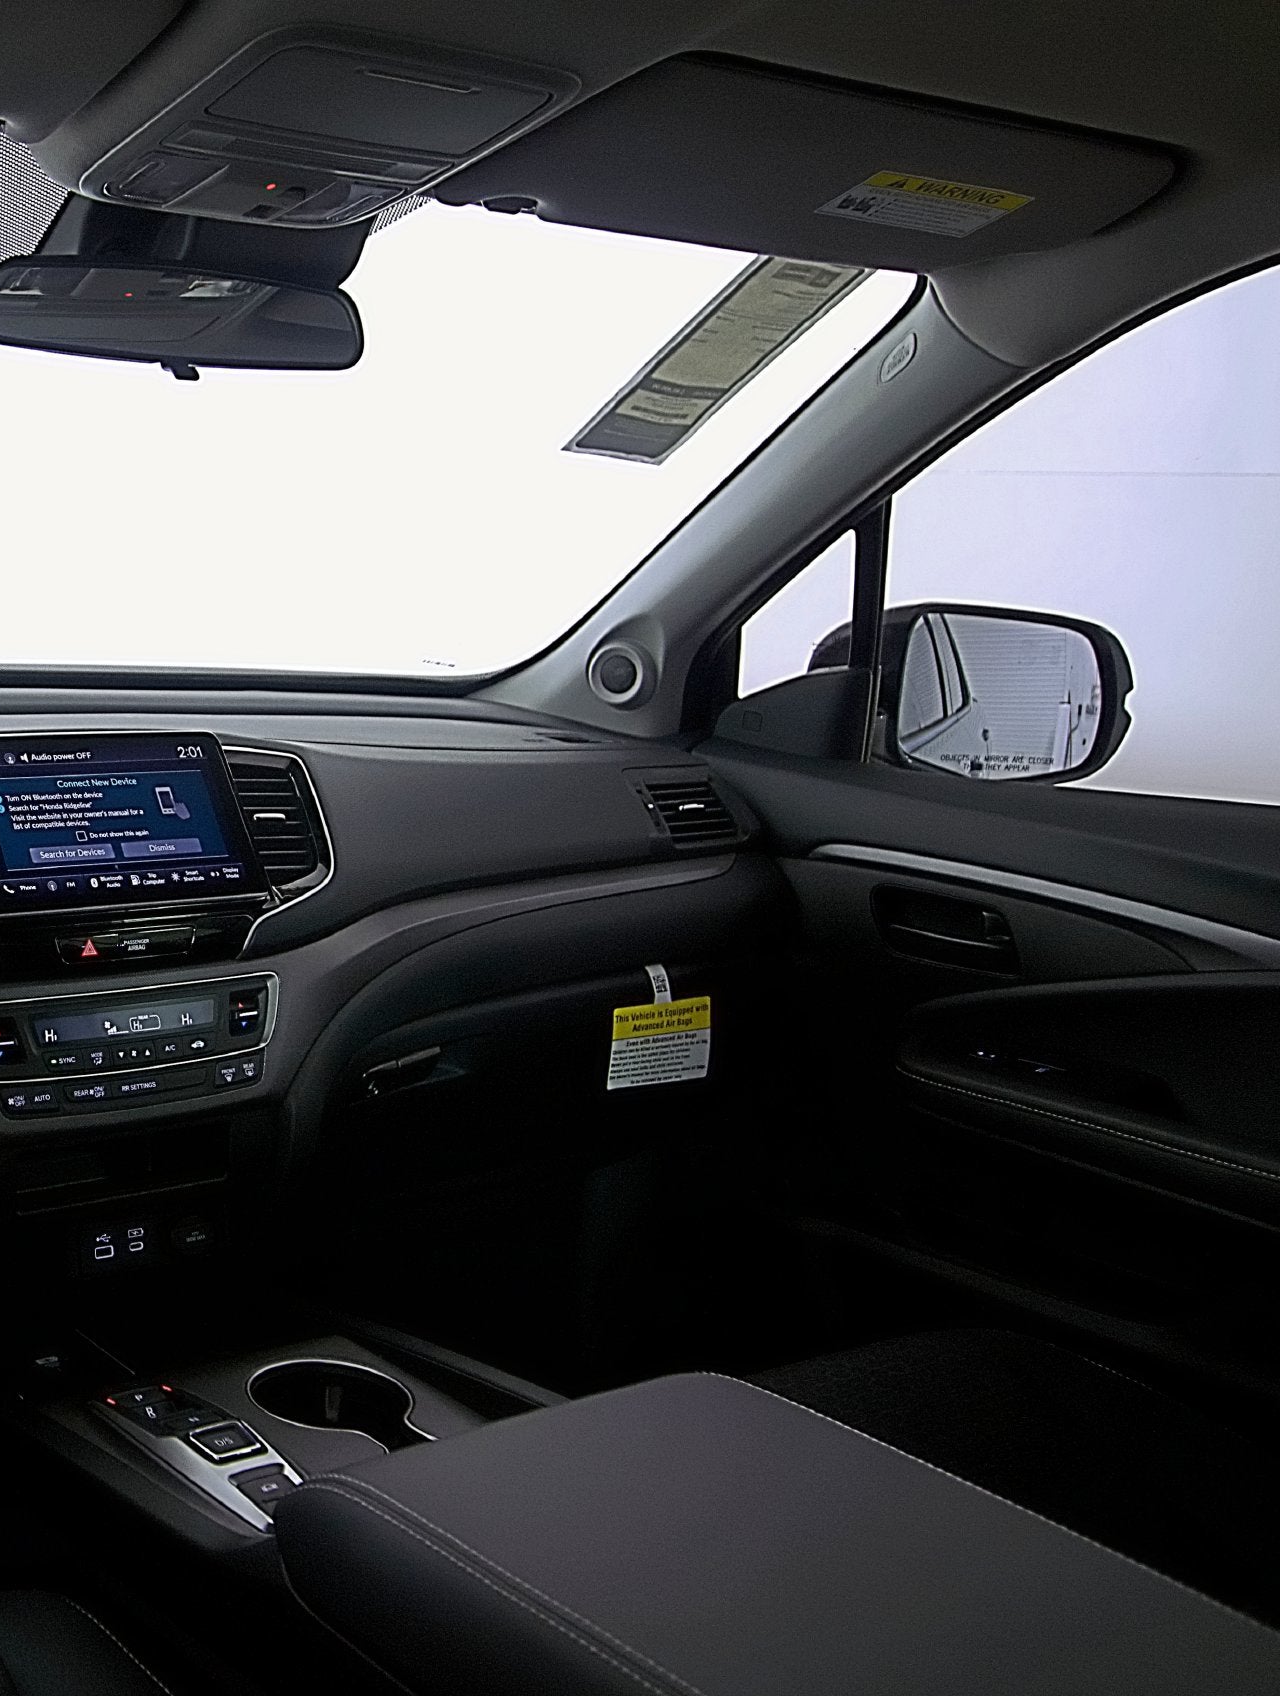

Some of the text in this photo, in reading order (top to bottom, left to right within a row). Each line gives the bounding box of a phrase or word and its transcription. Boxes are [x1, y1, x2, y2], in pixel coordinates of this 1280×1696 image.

[916, 181, 1005, 205] WARNING
[31, 751, 91, 761] Audio power OFF
[177, 746, 203, 758] 2:01
[940, 754, 970, 763] OBJECTS
[984, 755, 1009, 763] MIRROR
[1028, 757, 1054, 765] CLOSER
[984, 763, 1000, 771] THEY
[1004, 764, 1030, 772] APPEAR
[57, 777, 138, 788] Connect New Device
[32, 793, 63, 801] Bluetooth
[8, 804, 29, 812] Search
[30, 803, 39, 811] for
[38, 812, 61, 820] website
[69, 812, 83, 820] your
[84, 810, 107, 818] owner's
[108, 809, 129, 817] manual
[13, 822, 23, 830] list
[31, 820, 65, 829] compatible
[109, 830, 124, 838] show
[135, 829, 150, 837] again
[149, 843, 175, 852] Dismiss
[40, 847, 105, 859] Search for Devices
[616, 1003, 709, 1023] This Vehicle is Equipped with
[632, 1017, 693, 1032] Advanced Air Bags
[58, 1056, 76, 1064] SYNC
[130, 1081, 157, 1091] SETTINGS
[34, 1094, 51, 1102] AUTO
[73, 1089, 89, 1097] REAR
[145, 1405, 157, 1419] R
